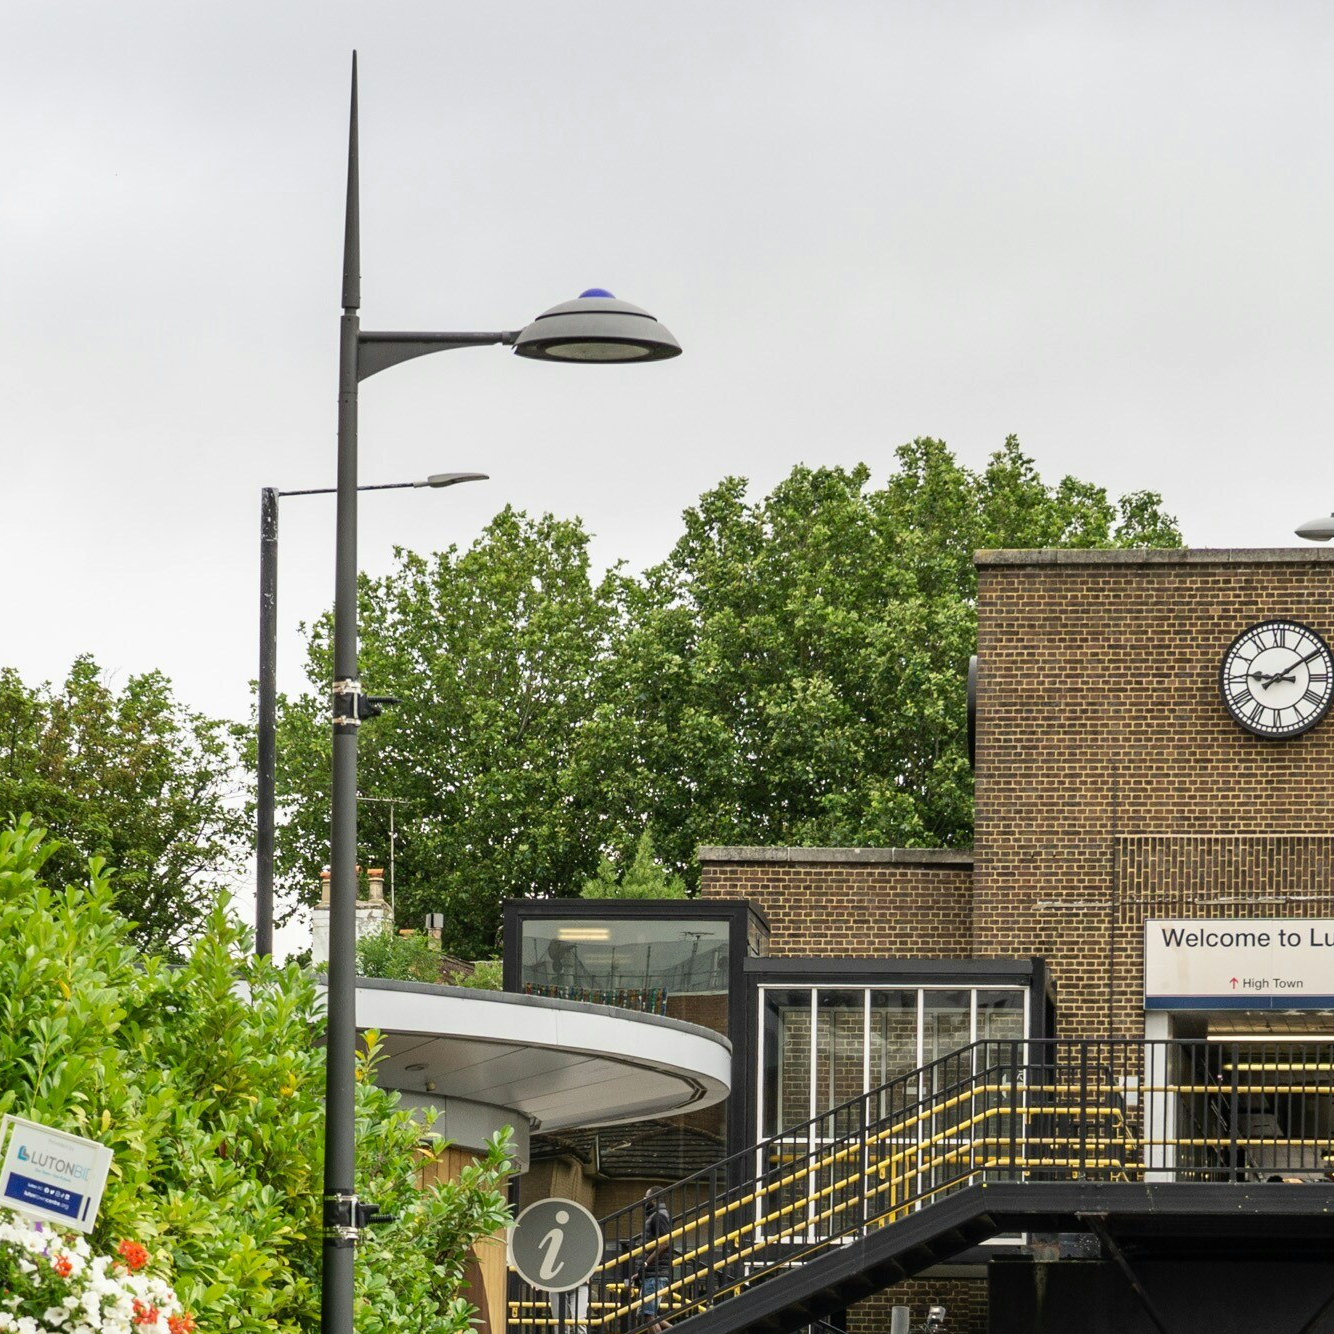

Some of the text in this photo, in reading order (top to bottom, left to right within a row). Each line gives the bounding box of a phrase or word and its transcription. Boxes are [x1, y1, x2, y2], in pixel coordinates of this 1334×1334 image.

[1162, 928, 1271, 948] Welcome
[1278, 929, 1301, 947] to
[1242, 978, 1304, 990] High Town
